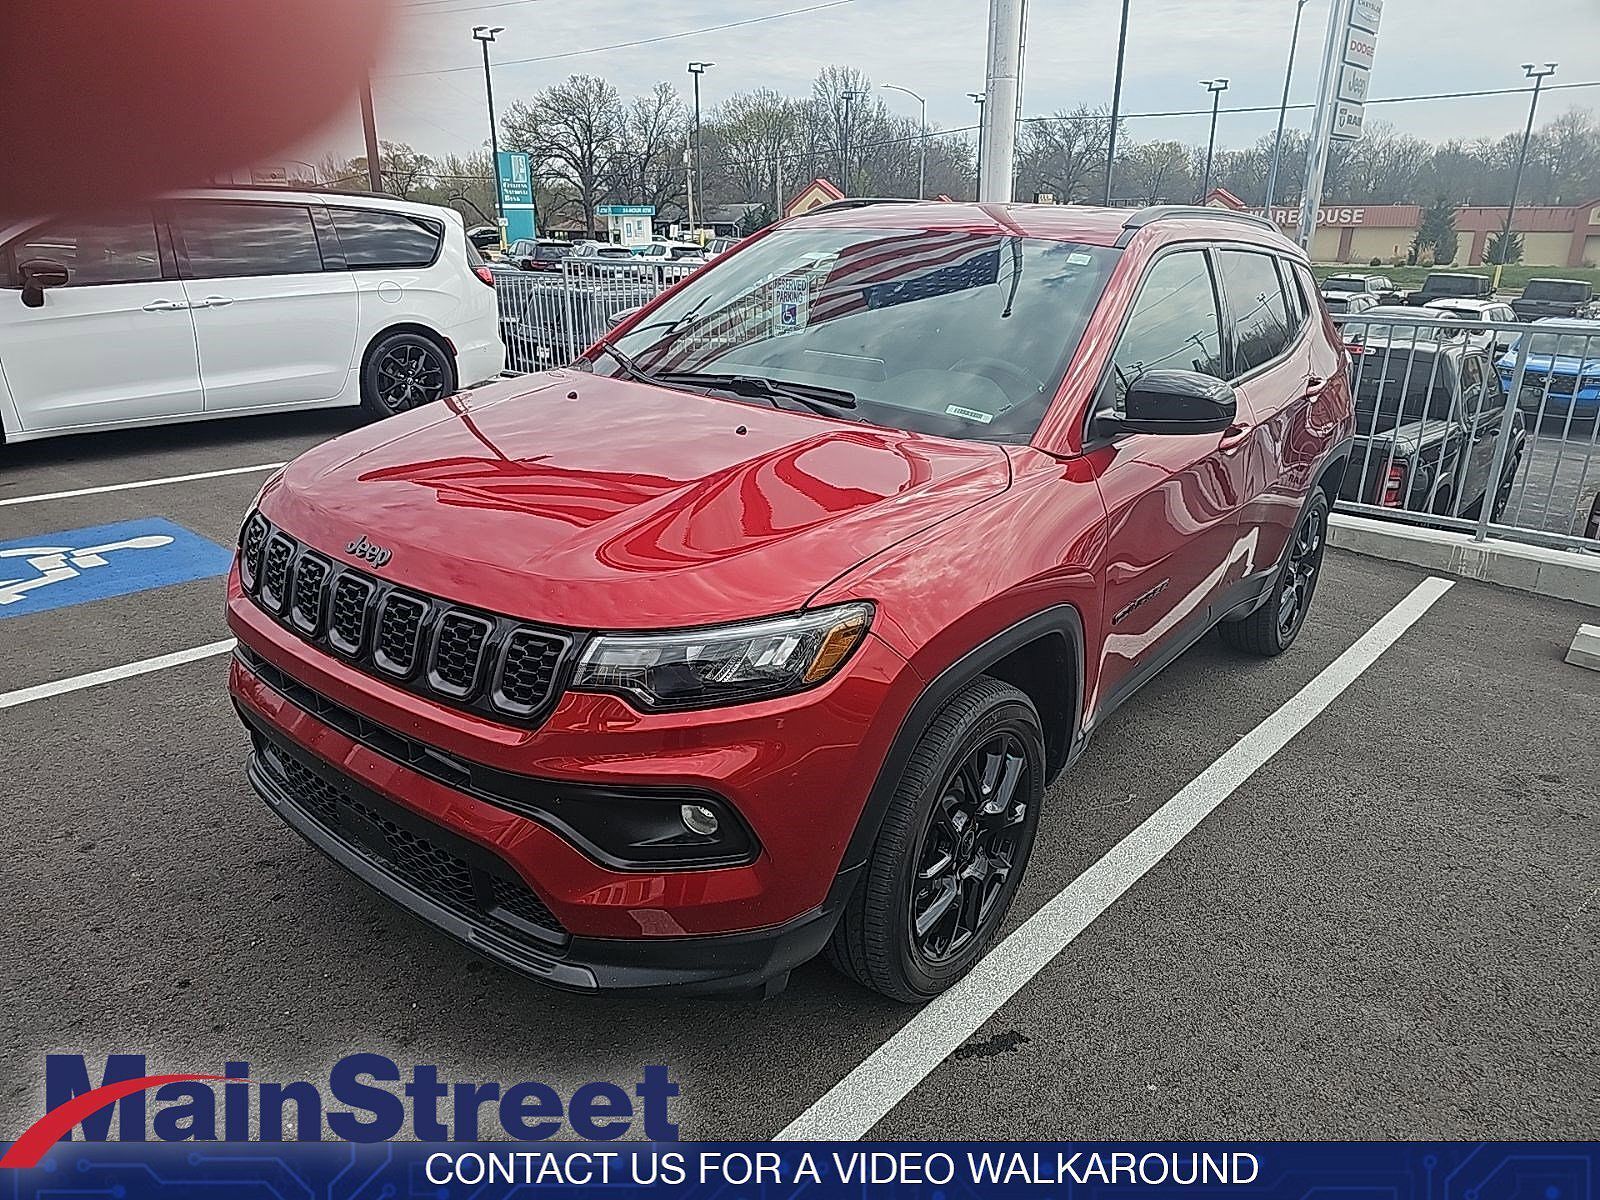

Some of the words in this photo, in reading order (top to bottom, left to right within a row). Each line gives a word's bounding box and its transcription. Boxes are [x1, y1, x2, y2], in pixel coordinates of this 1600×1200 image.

[1350, 40, 1375, 57] DODGE
[1349, 70, 1366, 99] Jeep
[1249, 208, 1365, 224] WREOUSE
[773, 278, 807, 291] RESERVED
[776, 290, 804, 303] PARKING
[345, 535, 392, 570] Jeep
